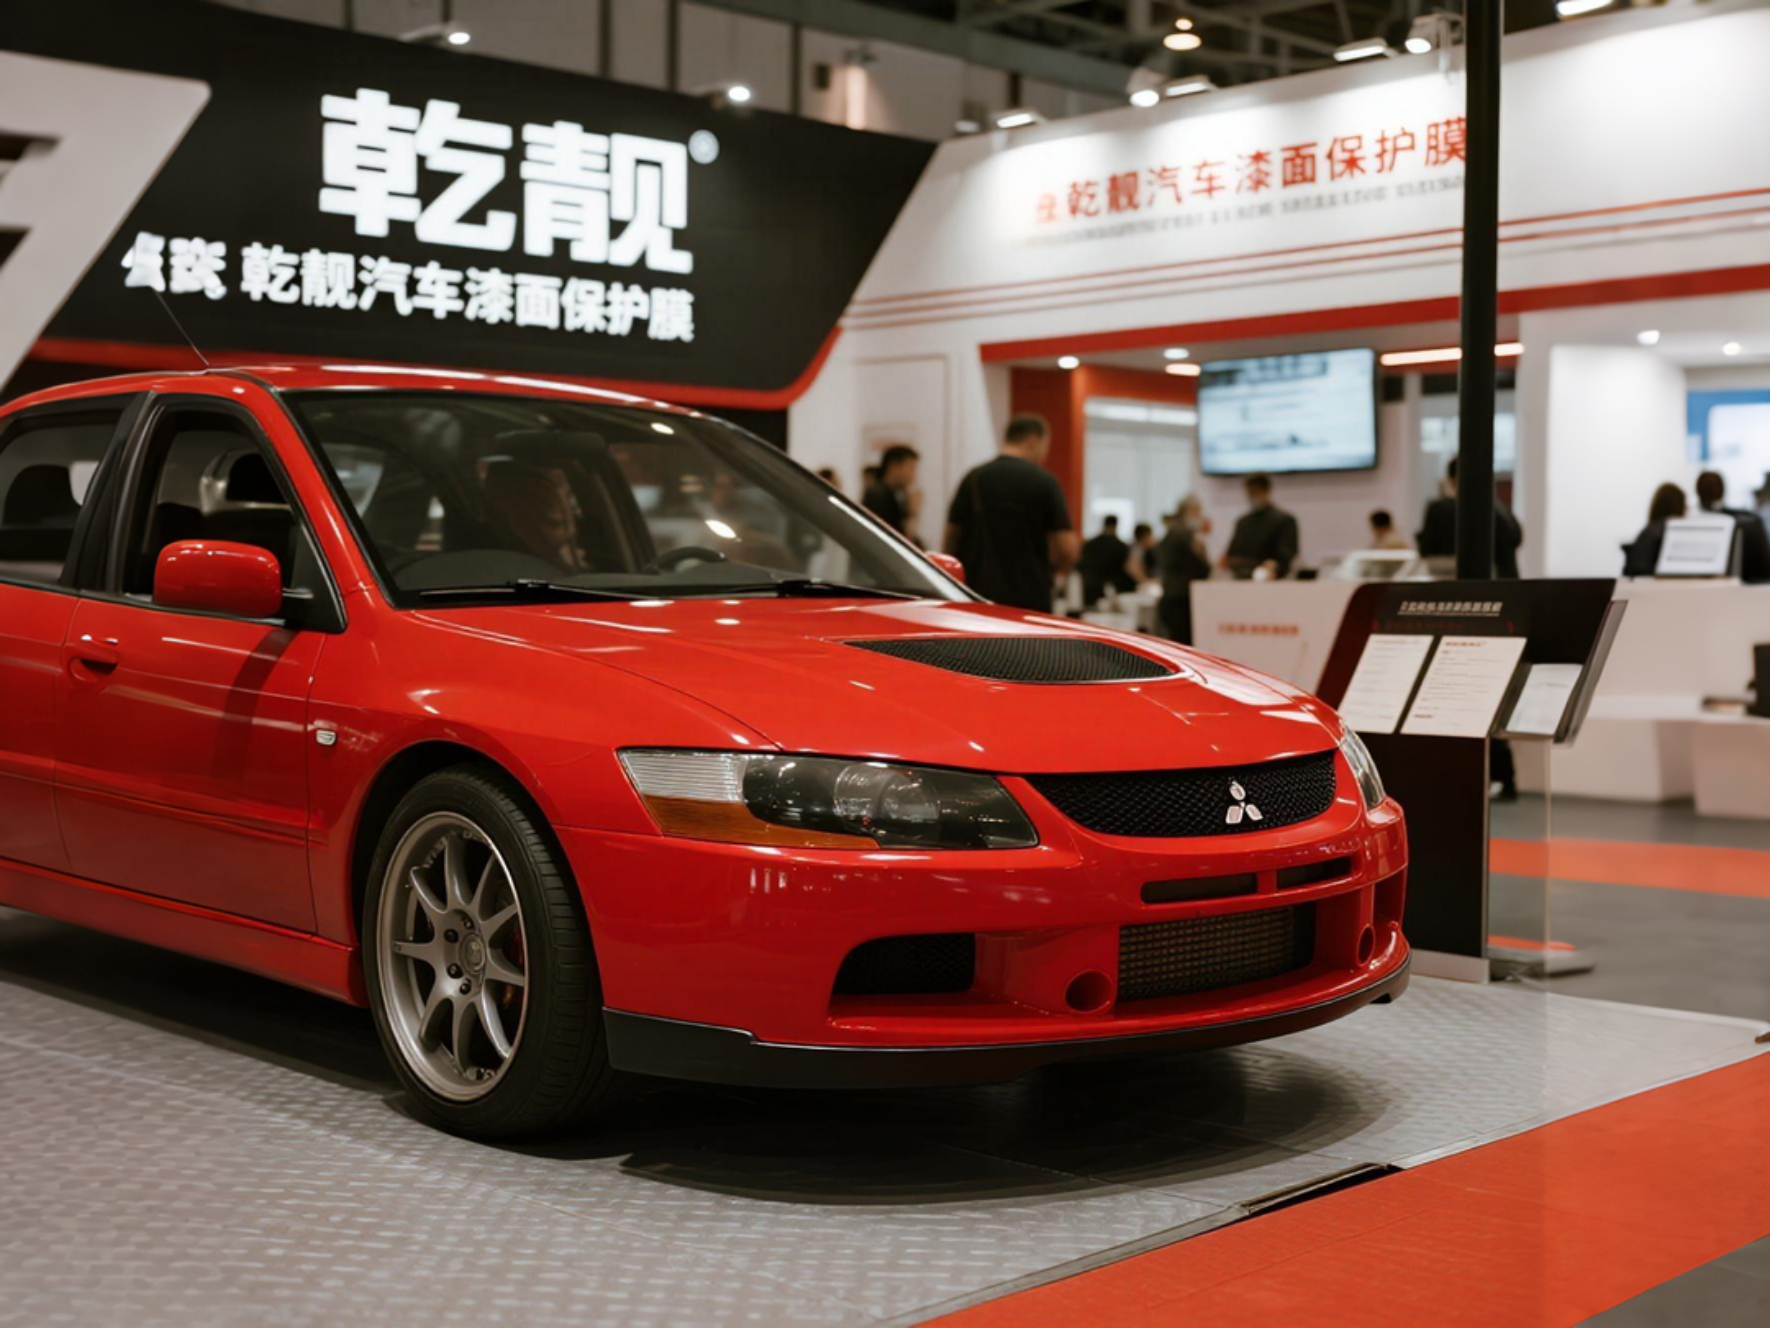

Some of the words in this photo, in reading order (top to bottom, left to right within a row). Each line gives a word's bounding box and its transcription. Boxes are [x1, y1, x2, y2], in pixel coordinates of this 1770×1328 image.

[319, 88, 693, 274] 乾靓
[240, 242, 694, 342] 乾靓汽车漆面保护膜
